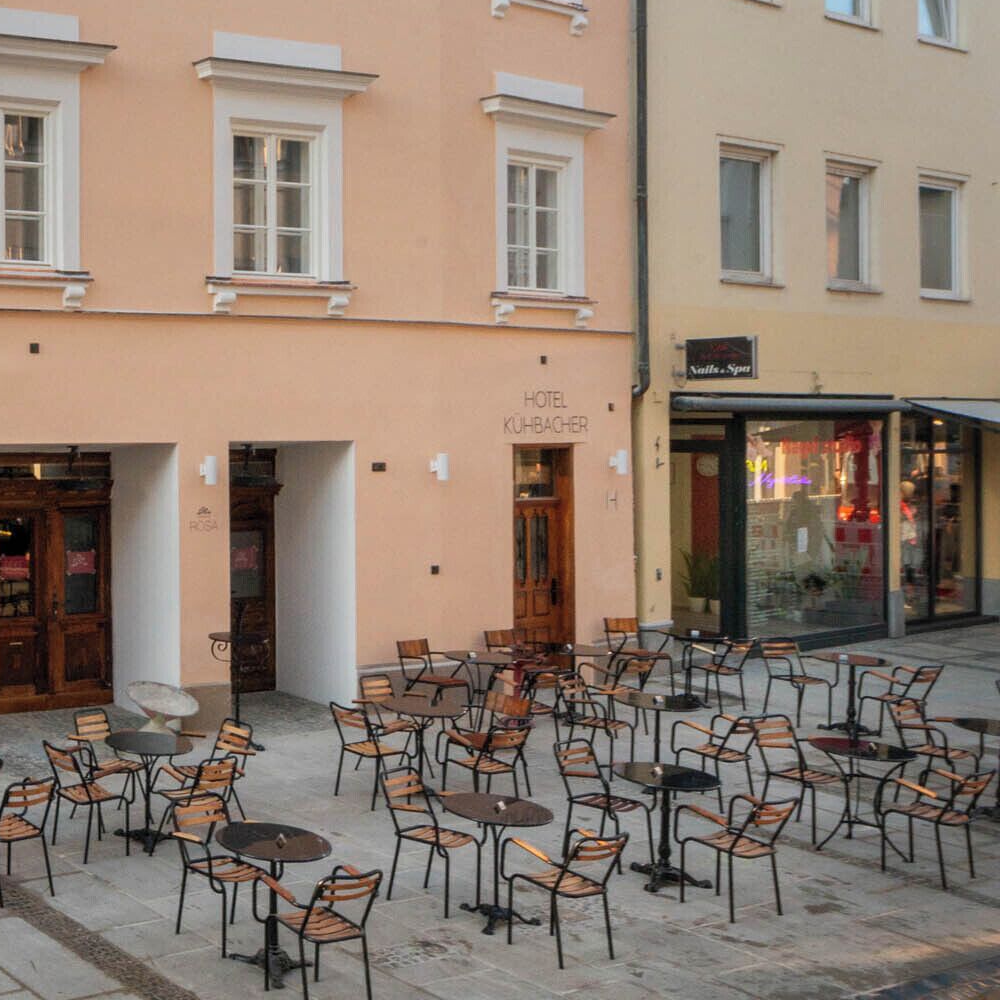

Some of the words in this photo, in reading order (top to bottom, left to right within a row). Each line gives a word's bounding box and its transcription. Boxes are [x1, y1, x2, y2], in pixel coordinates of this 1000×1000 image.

[689, 364, 718, 375] Nails
[727, 362, 751, 376] Spa
[523, 390, 568, 408] HOTEL
[503, 412, 589, 434] KÜHBACHER
